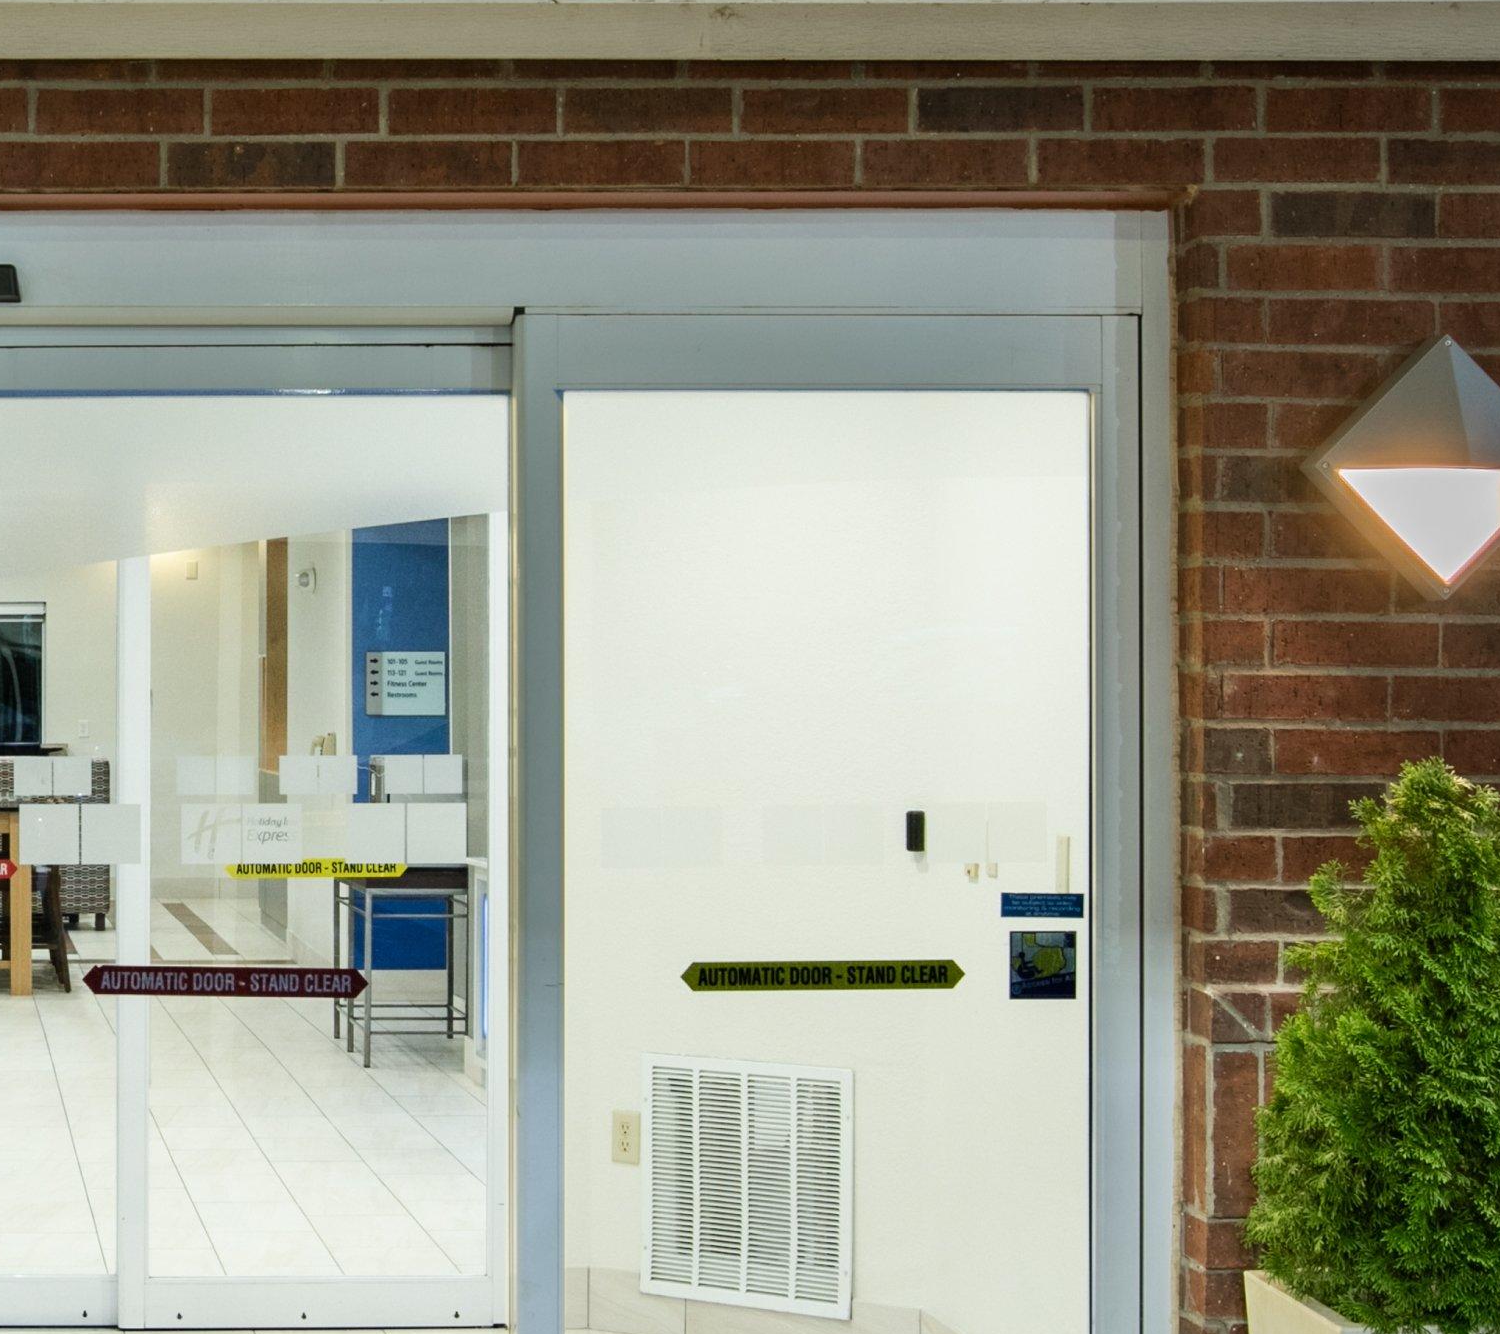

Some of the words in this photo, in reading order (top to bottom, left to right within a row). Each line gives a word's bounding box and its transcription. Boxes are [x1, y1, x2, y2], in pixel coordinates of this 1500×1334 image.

[236, 864, 292, 875] AUTOMATIC
[295, 862, 322, 874] DOOR
[331, 862, 362, 874] STAND
[100, 970, 188, 991] AUTOMATIC
[193, 972, 235, 991] DOOR
[250, 973, 299, 992] STAND
[303, 974, 351, 993] CLEAR
[698, 967, 785, 986] AUTOMATIC
[790, 966, 832, 985] DOOR
[846, 965, 896, 985] STAND
[901, 965, 948, 984] CLEAR
